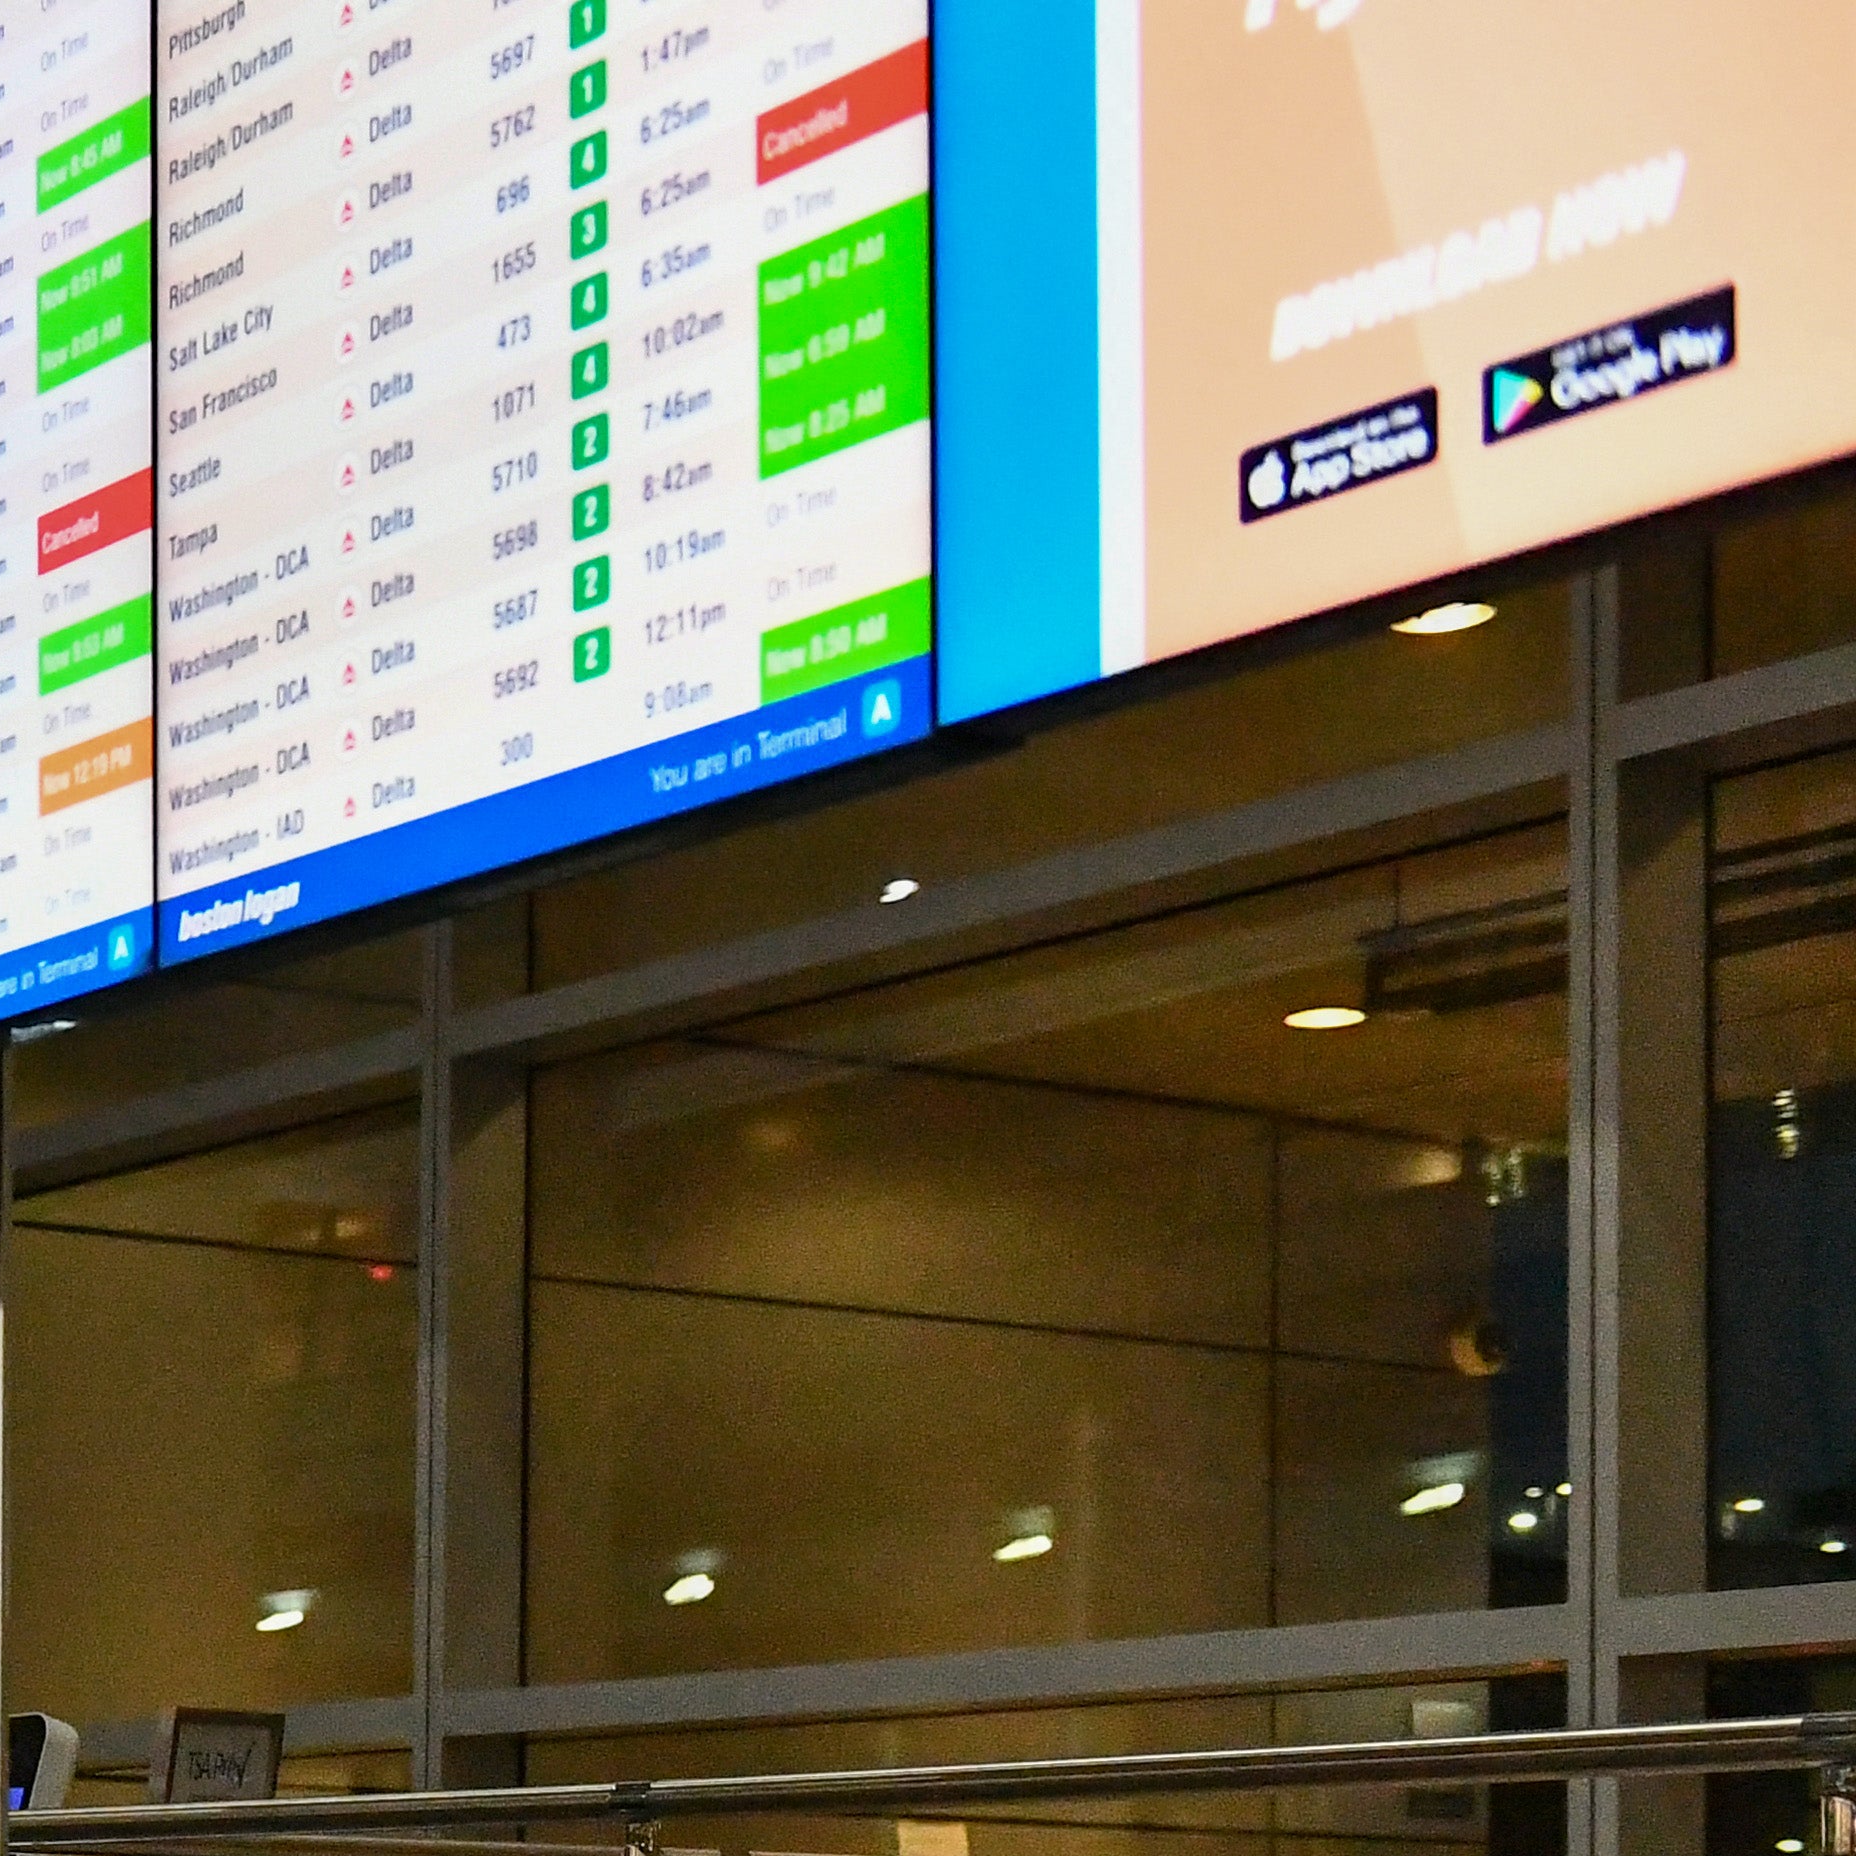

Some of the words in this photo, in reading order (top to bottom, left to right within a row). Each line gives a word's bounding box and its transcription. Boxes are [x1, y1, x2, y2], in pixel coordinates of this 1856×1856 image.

[490, 33, 535, 80] 5697
[369, 104, 412, 144] Delta
[490, 103, 536, 150] 5762
[640, 98, 710, 145] 6:25am
[762, 98, 849, 160] Cancelled
[169, 186, 244, 247] Richmond
[491, 241, 536, 284] 1655
[169, 338, 197, 372] Salt
[203, 322, 238, 356] Lake
[244, 305, 274, 335] City
[642, 310, 724, 359] 10:02am
[1551, 349, 1659, 411] Google
[1658, 326, 1726, 376] Play
[169, 406, 197, 435] San
[202, 367, 277, 419] Francisco
[169, 456, 221, 498] Seattle
[491, 450, 538, 493] 5710
[642, 461, 713, 503] 8:42am
[1291, 454, 1350, 499] App
[1350, 426, 1430, 479] Store
[42, 511, 99, 555] Cancelled
[169, 523, 218, 560] Tampa
[645, 603, 726, 644] 12:11pm
[650, 765, 689, 794] You
[693, 752, 728, 782] are
[731, 744, 752, 772] in
[756, 707, 848, 762] Terminal
[870, 693, 893, 726] A
[178, 893, 246, 943] boston
[244, 881, 300, 926] logan
[21, 970, 35, 991] in
[37, 945, 99, 985] Terminal
[112, 935, 129, 961] A
